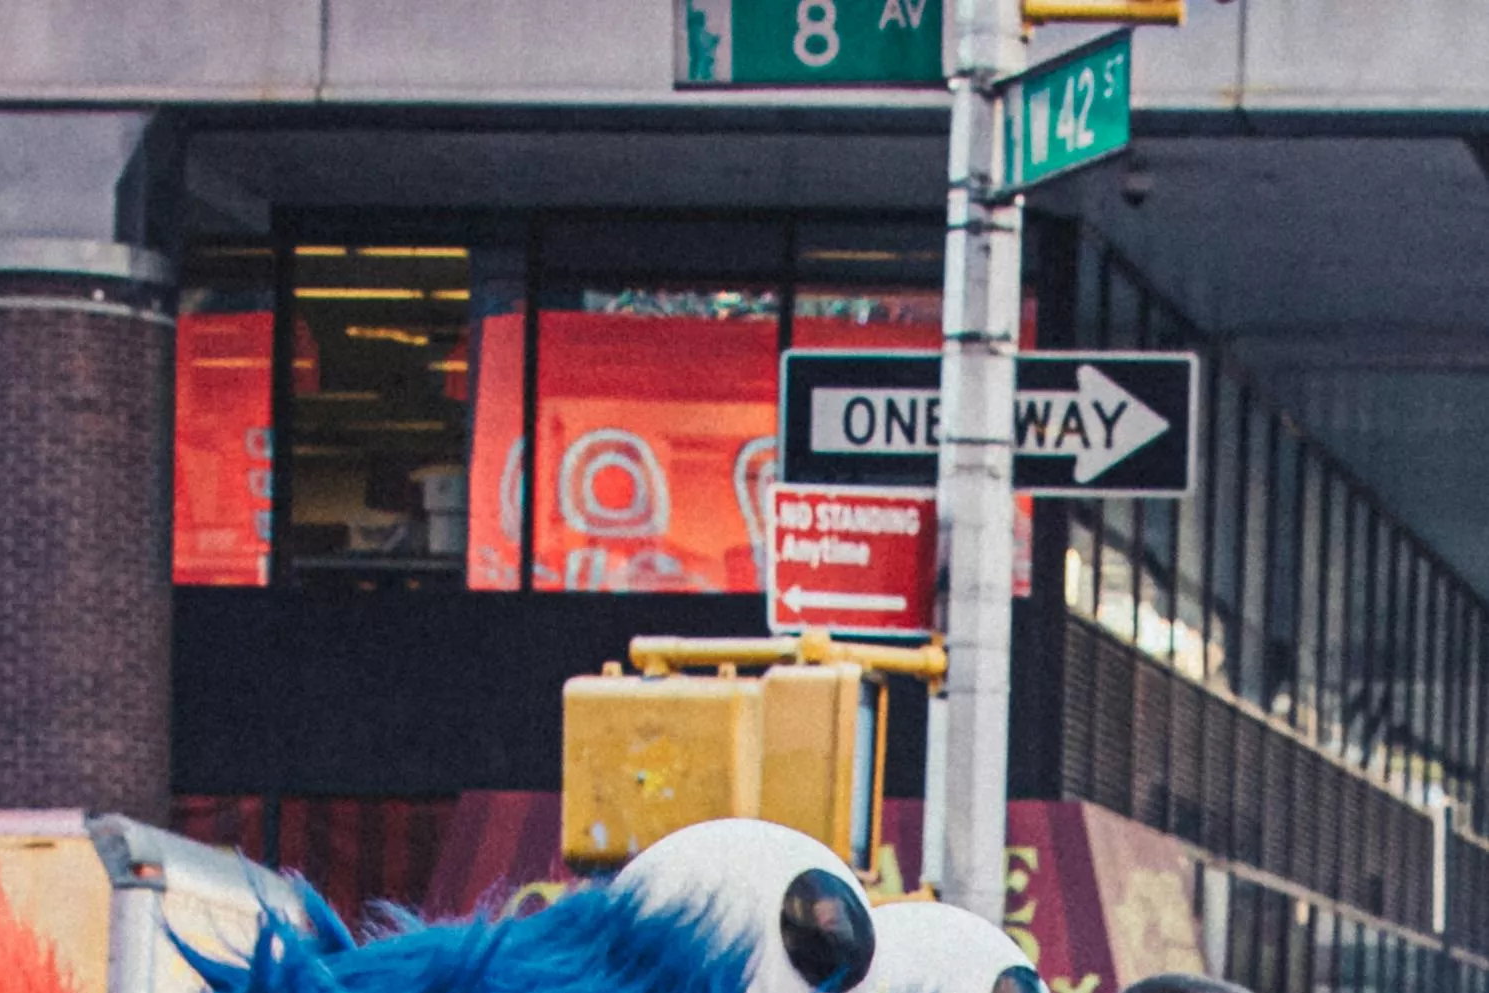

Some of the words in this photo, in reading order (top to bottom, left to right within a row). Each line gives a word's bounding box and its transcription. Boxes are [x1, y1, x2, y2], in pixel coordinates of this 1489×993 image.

[793, 0, 840, 67] 8
[878, 0, 926, 30] AV
[1029, 86, 1051, 166] W
[1056, 66, 1095, 153] 42
[843, 396, 940, 446] ONE
[1013, 400, 1128, 449] WAY
[779, 501, 813, 532] NO
[816, 501, 921, 536] STANDING
[782, 533, 871, 570] Anytime
